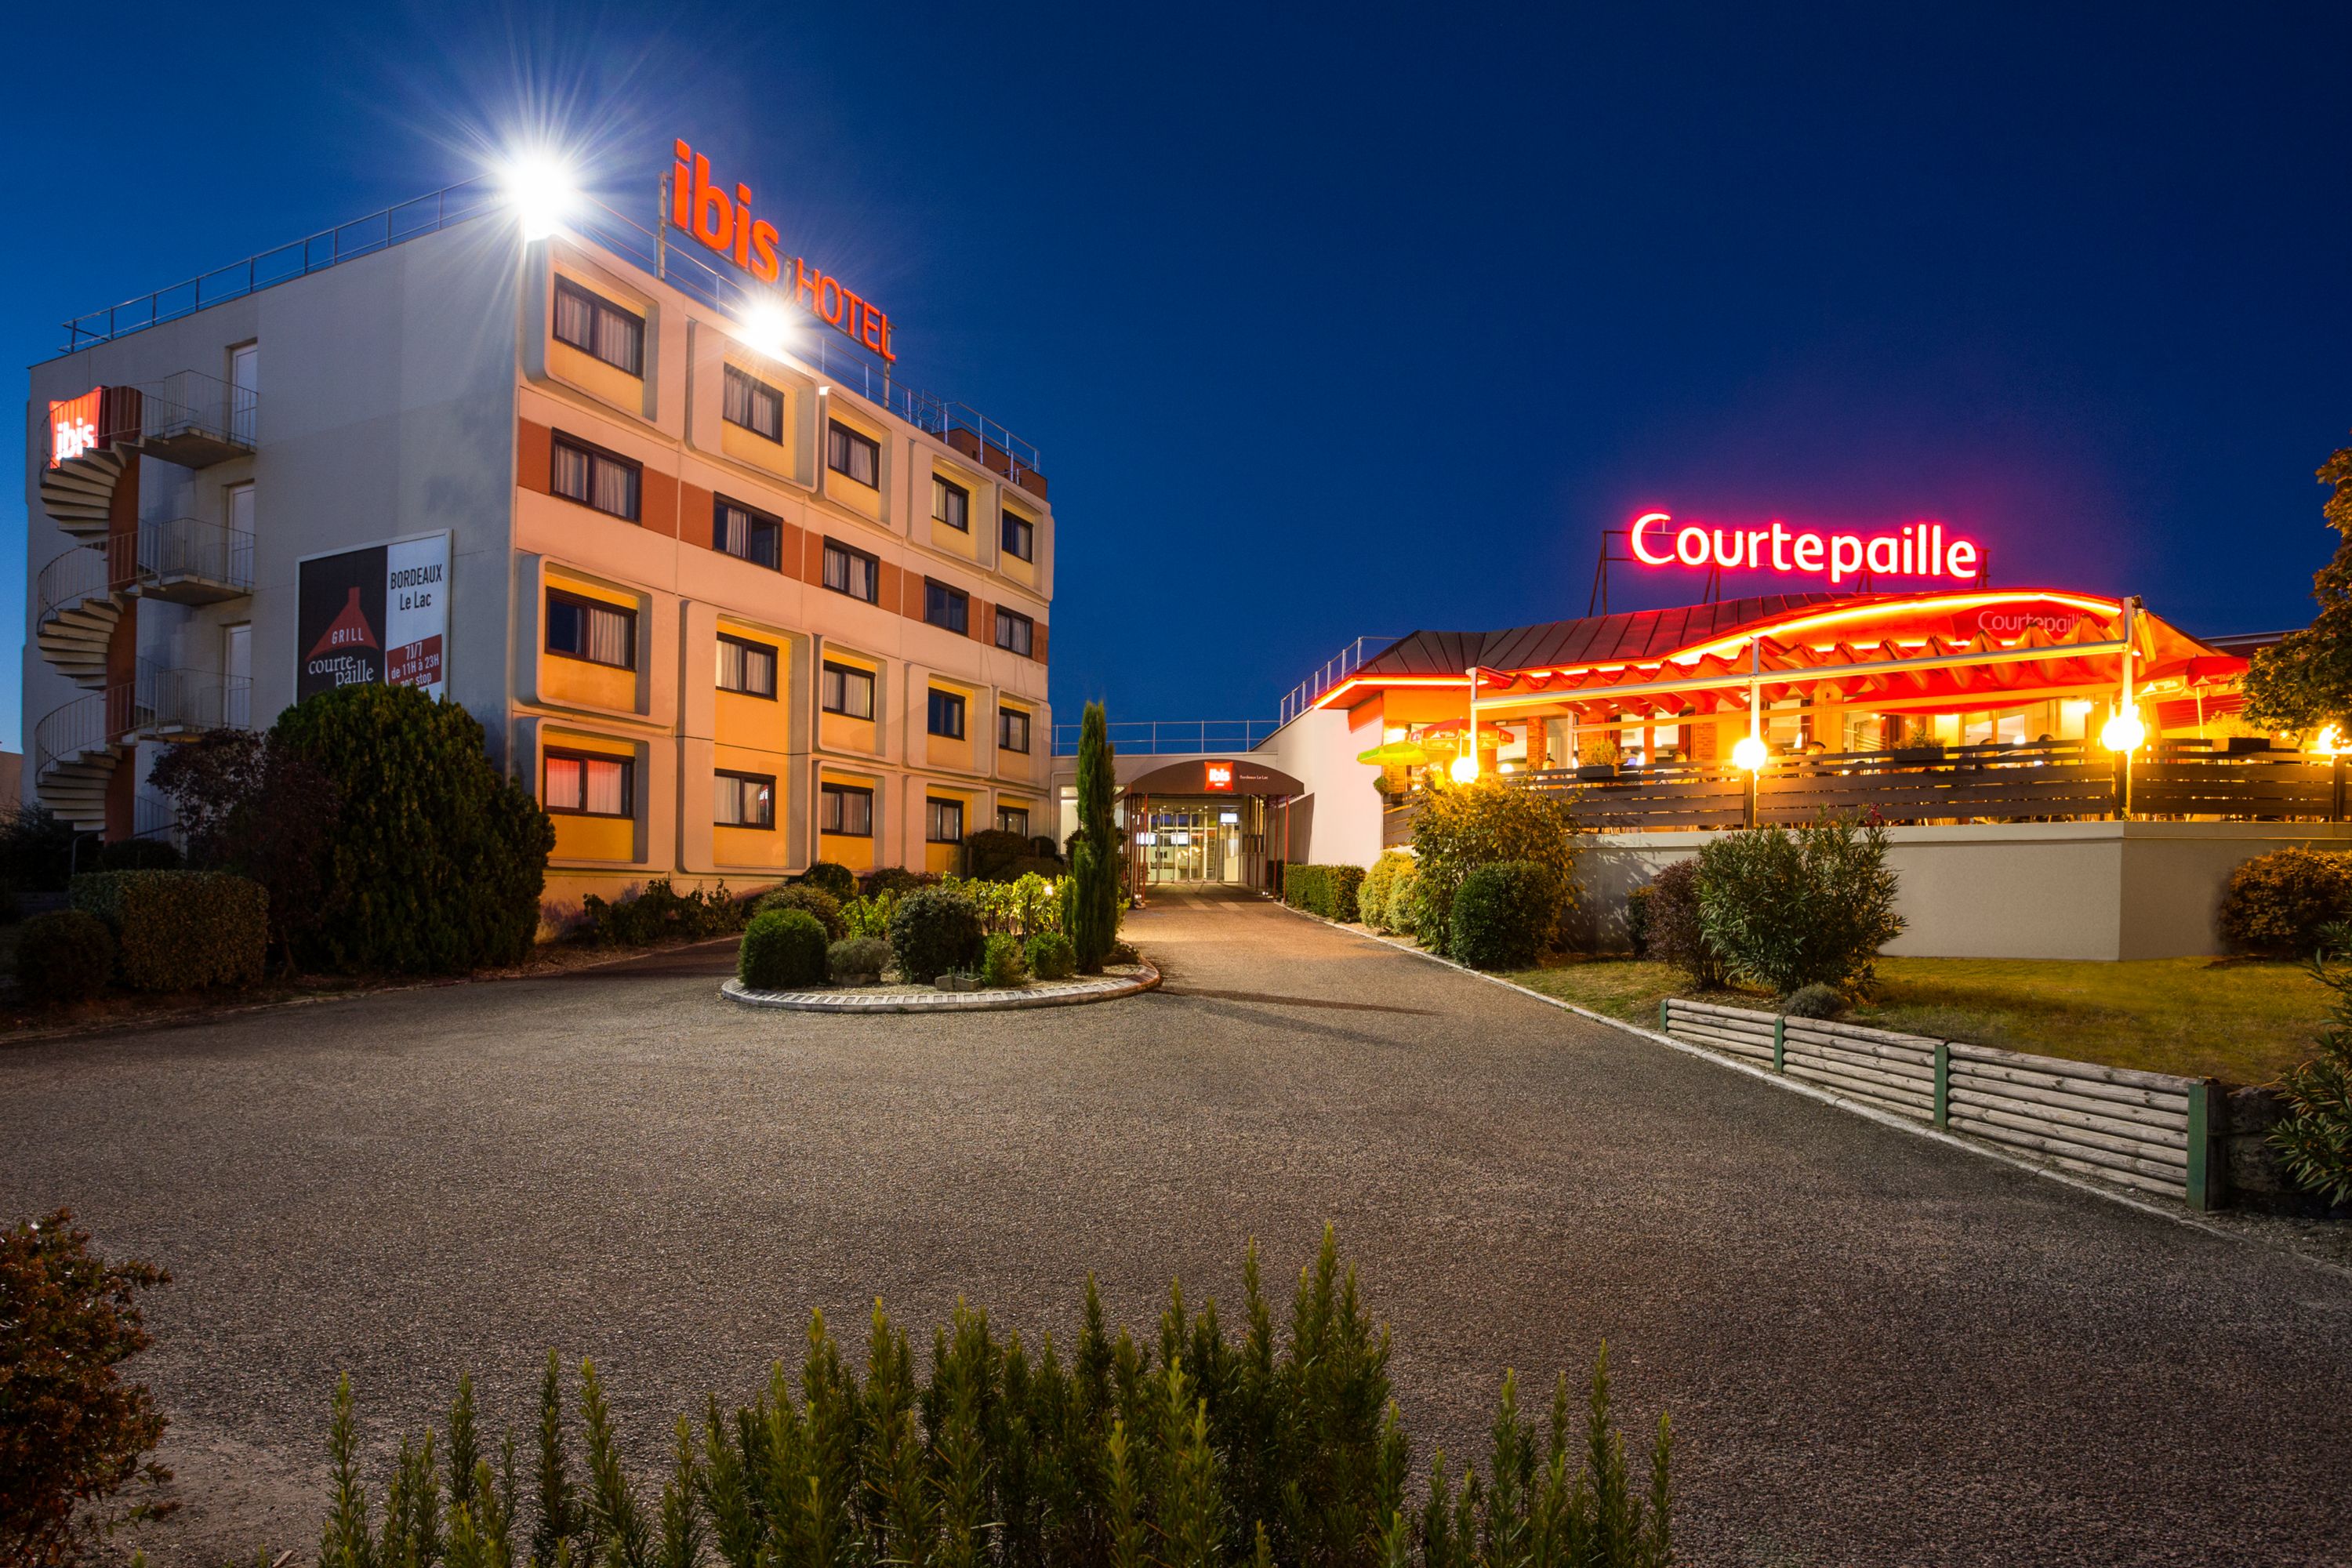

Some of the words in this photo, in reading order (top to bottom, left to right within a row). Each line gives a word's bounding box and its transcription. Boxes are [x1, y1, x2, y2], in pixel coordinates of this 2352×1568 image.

[672, 138, 779, 283] ibis
[795, 257, 896, 361] HOTEL
[56, 417, 95, 461] ibis
[1632, 513, 1976, 583] Courtepaille
[390, 564, 442, 590] BORDEAUX
[400, 593, 411, 611] Le
[414, 591, 431, 608] Lac
[1978, 611, 2082, 633] Courtepail
[332, 627, 364, 644] GRILL
[336, 659, 374, 689] paille
[391, 667, 401, 679] de
[402, 661, 416, 676] 11H
[418, 659, 423, 671] à
[425, 653, 439, 669] 23H
[416, 673, 432, 685] stop
